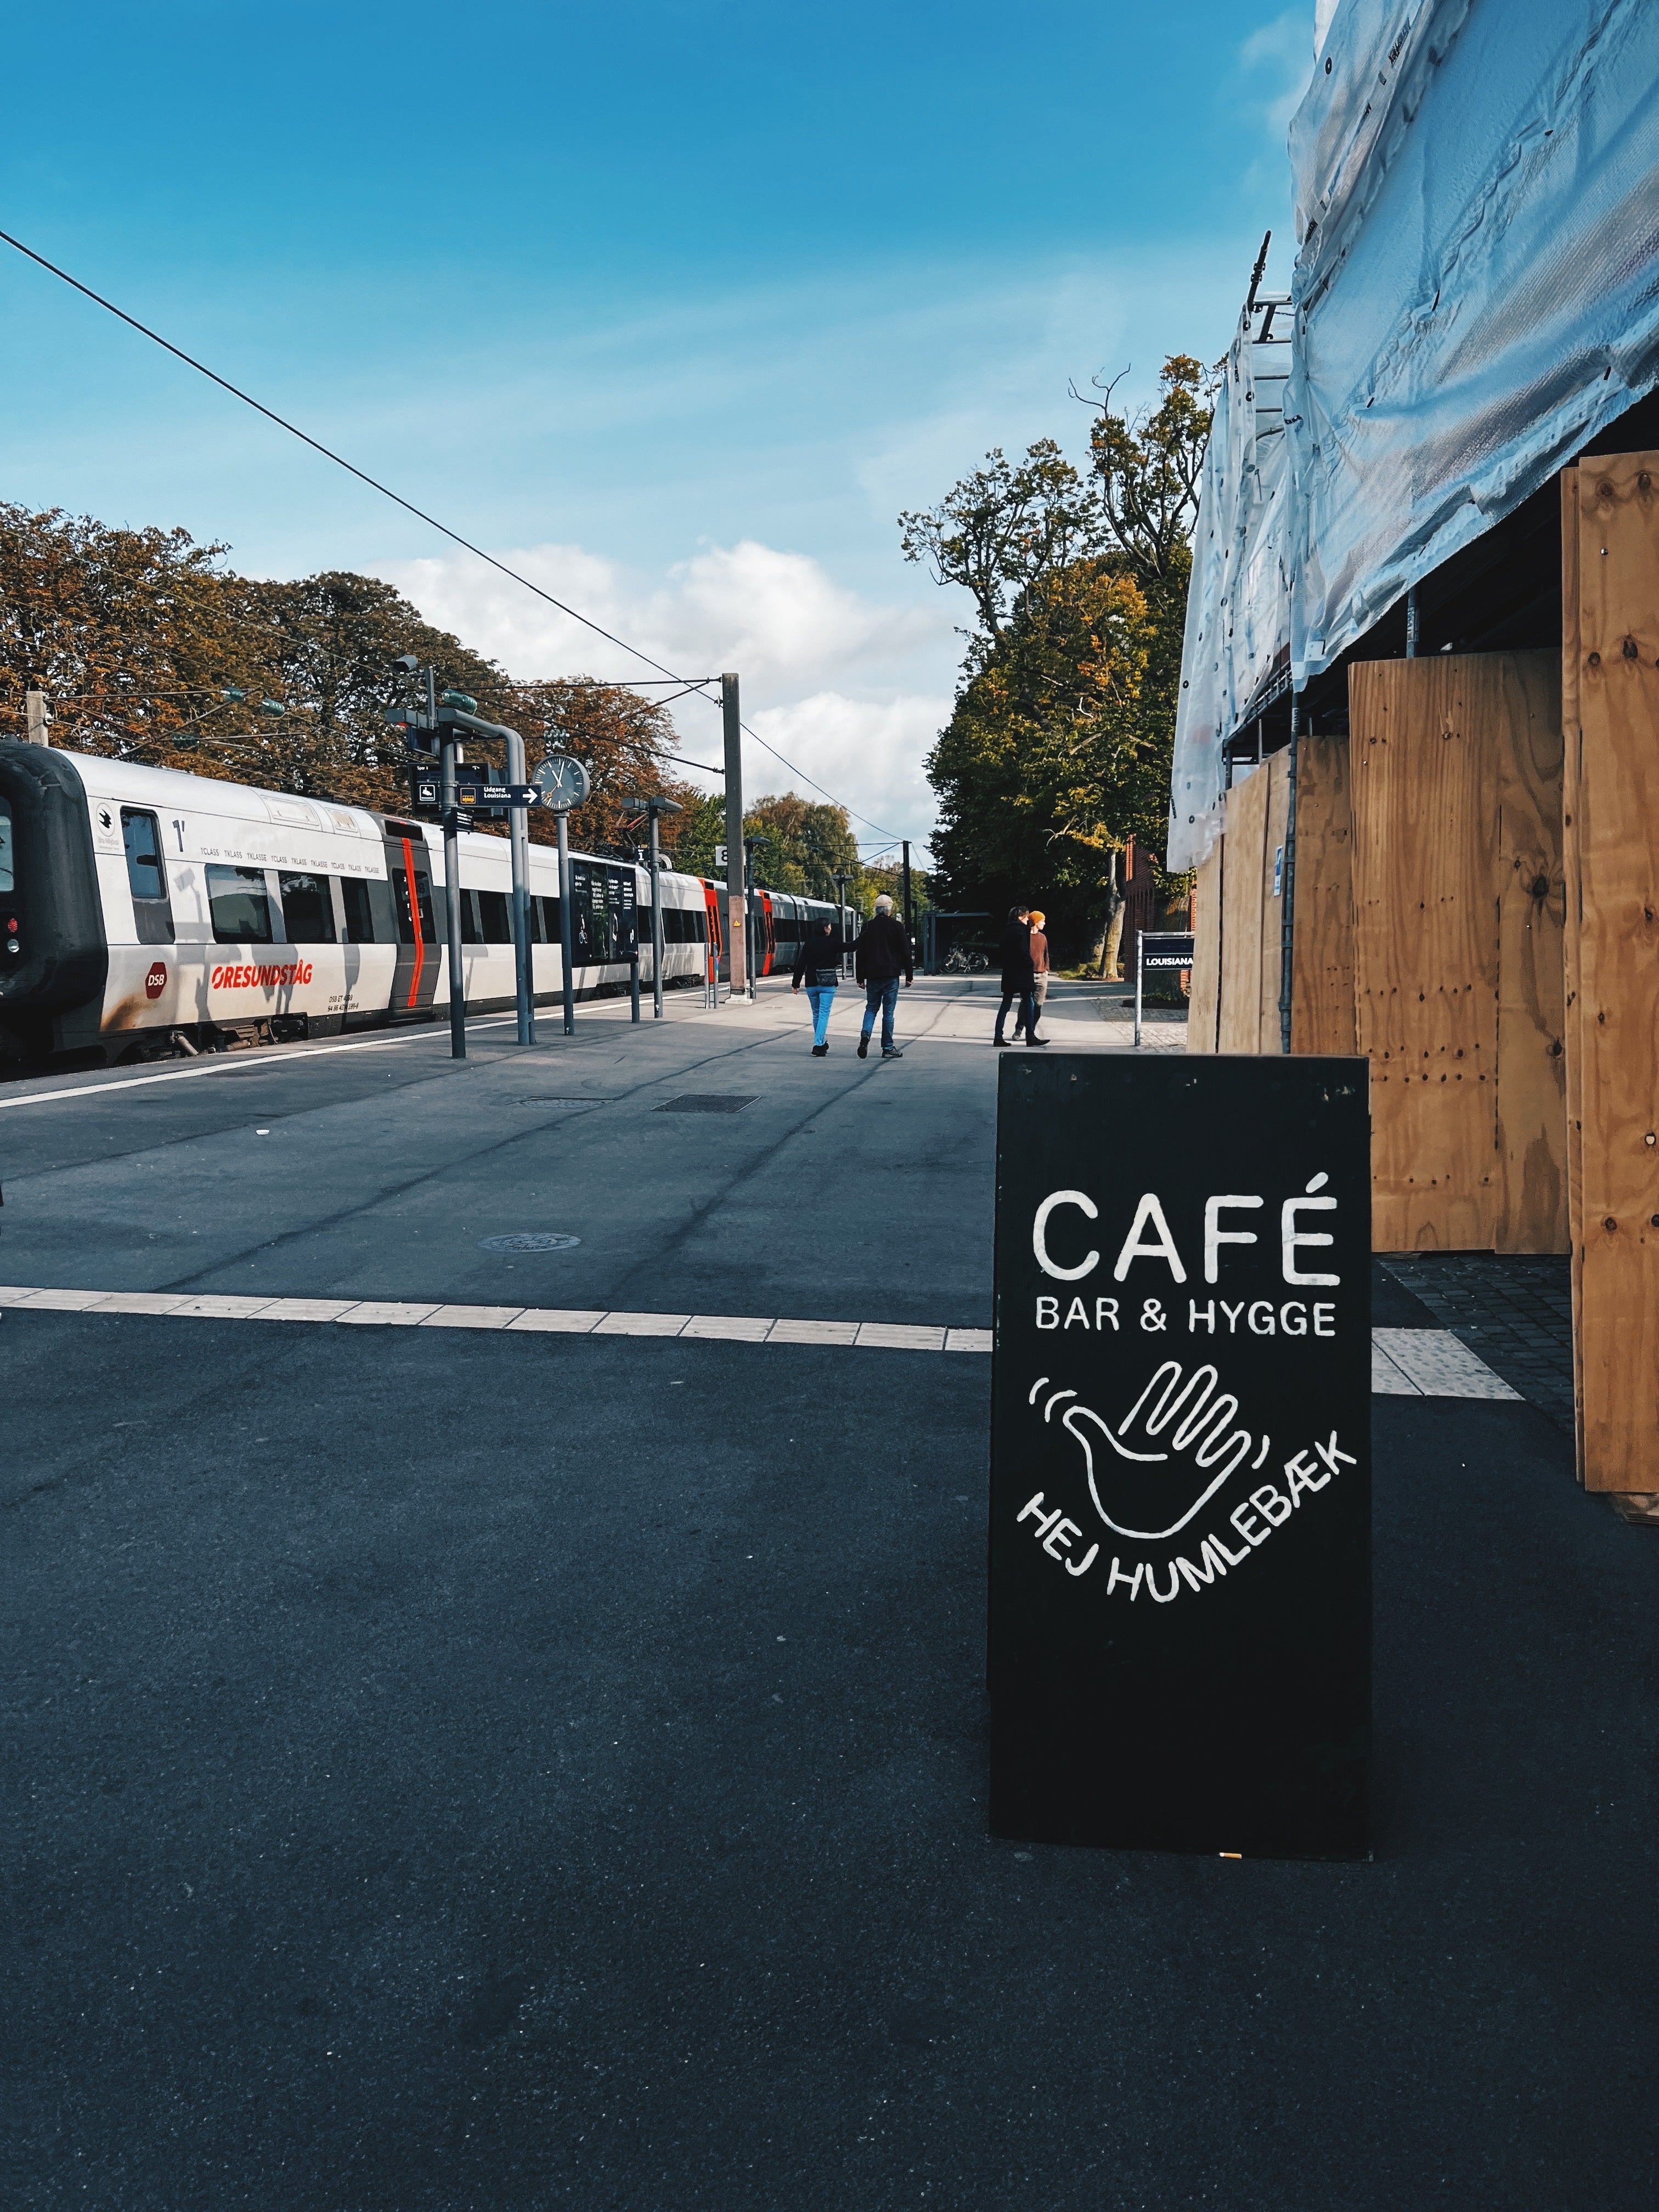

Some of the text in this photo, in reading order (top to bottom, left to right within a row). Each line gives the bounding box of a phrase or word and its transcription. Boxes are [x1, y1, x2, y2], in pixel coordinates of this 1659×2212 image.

[148, 974, 165, 986] DSB
[1146, 957, 1194, 966] LOUISIANA
[1033, 1172, 1340, 1286] CAFÉ
[1036, 1296, 1336, 1336] BAR & HYGGE
[1016, 1430, 1357, 1603] HEJ HUMLEBÆK
